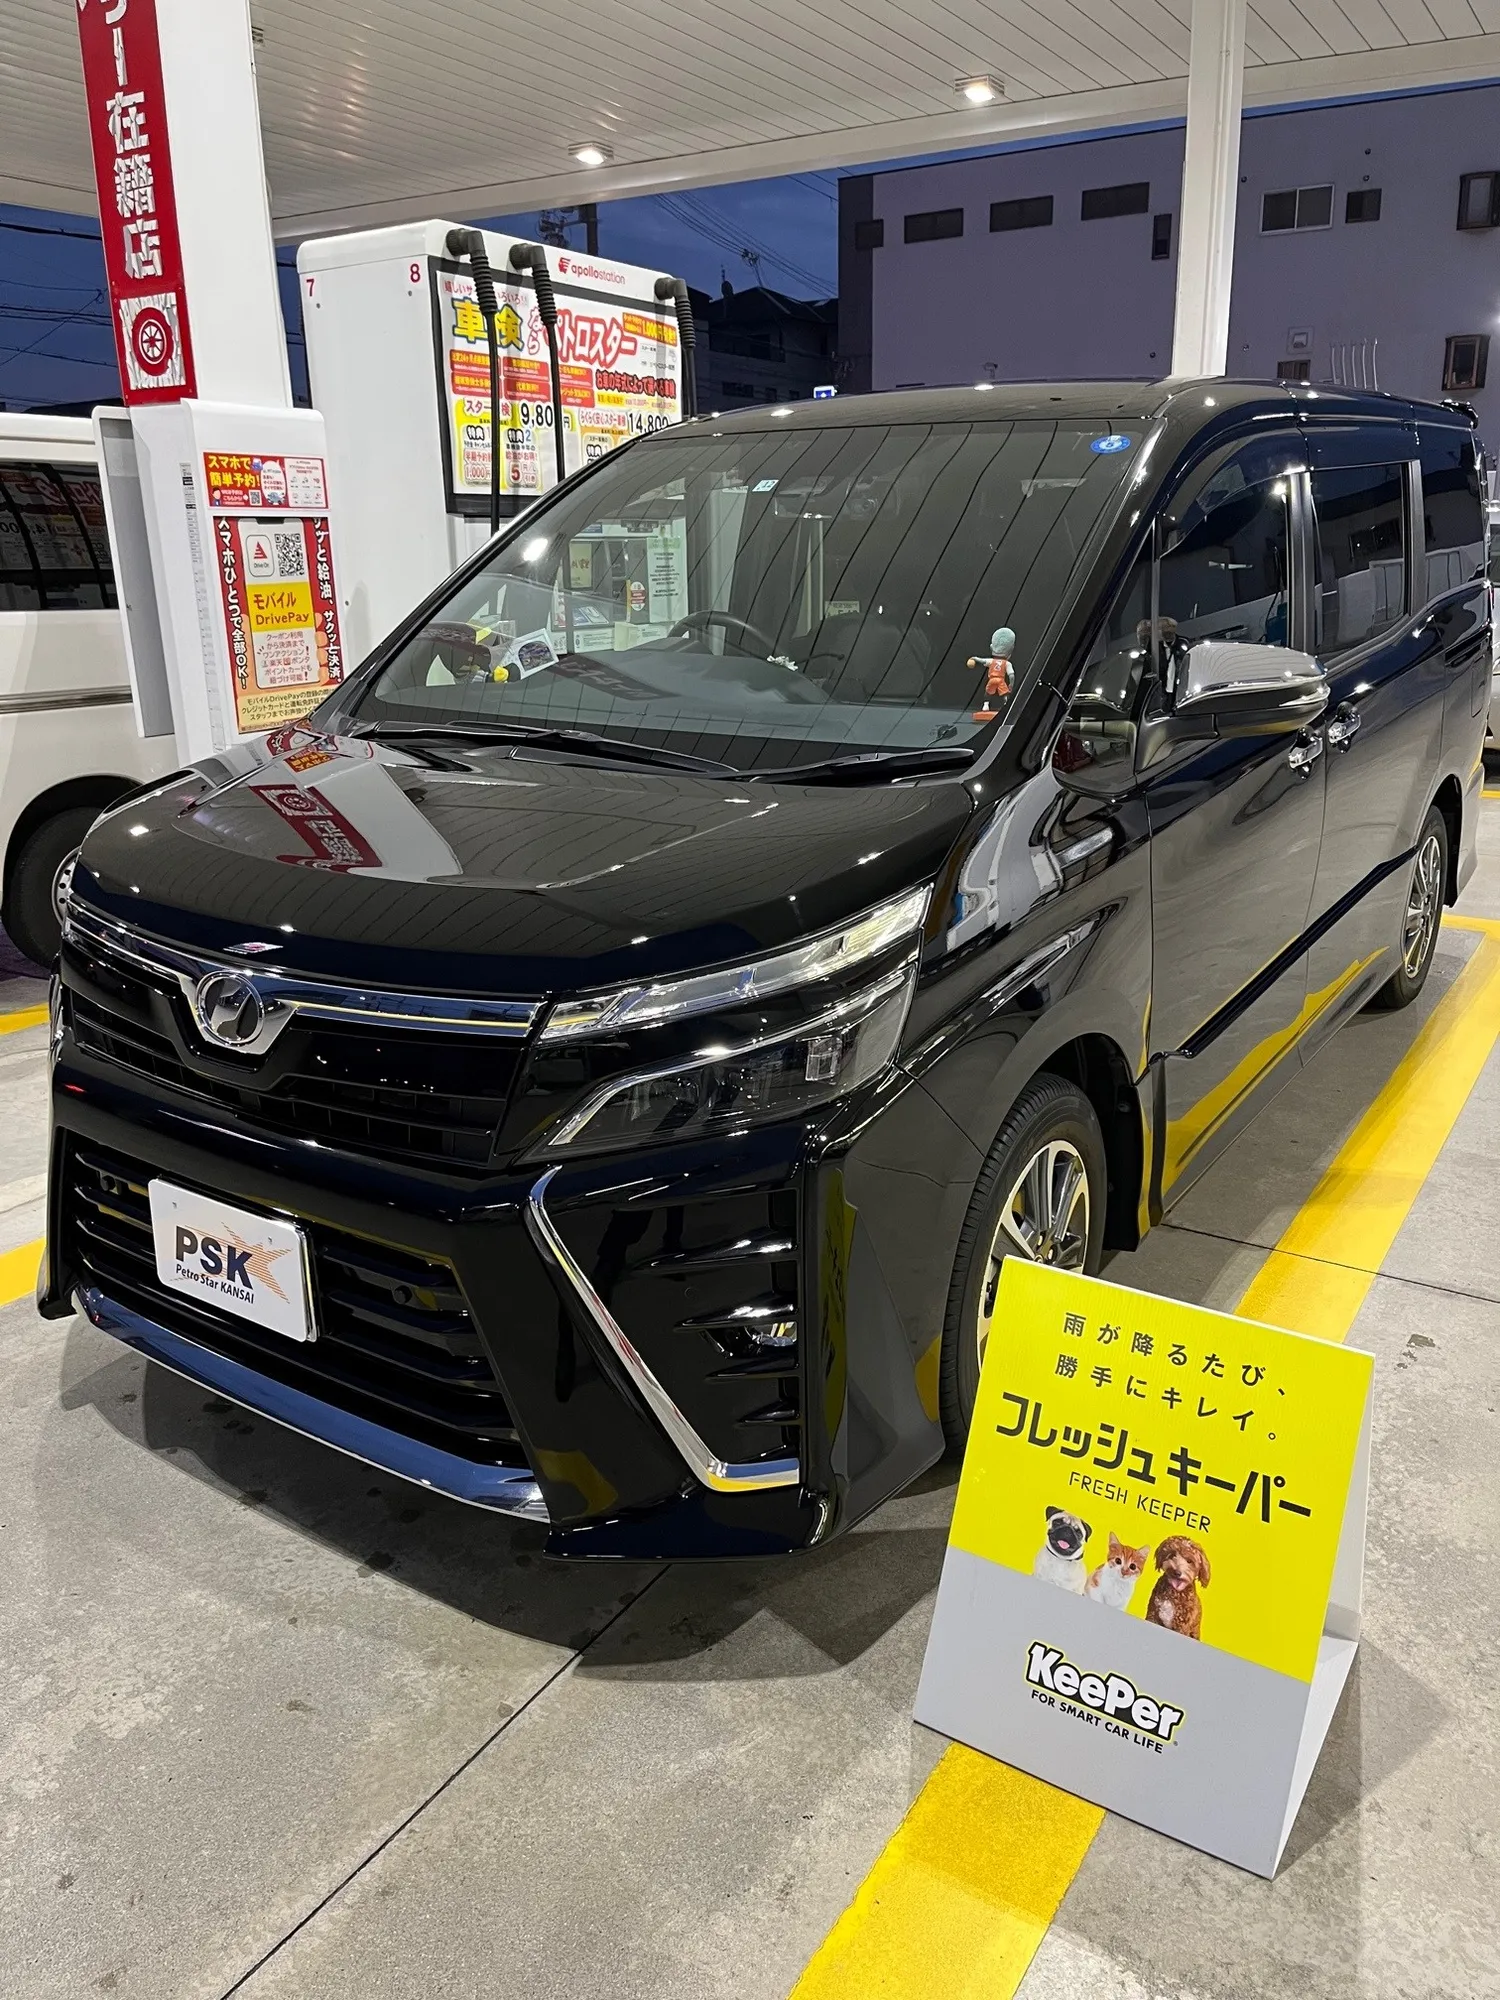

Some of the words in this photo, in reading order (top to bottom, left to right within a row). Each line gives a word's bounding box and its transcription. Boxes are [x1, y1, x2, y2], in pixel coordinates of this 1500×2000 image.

[410, 263, 421, 283] 8
[571, 264, 626, 285] apollostation
[306, 278, 315, 297] 7
[466, 400, 511, 419] スター検
[208, 455, 251, 470] スマホで
[209, 472, 260, 488] 簡単予約!
[511, 464, 520, 481] 5
[254, 591, 297, 610] モバイル
[256, 612, 310, 625] DrivePay
[266, 631, 304, 641] クーポン利用
[267, 640, 305, 650] から決済まで
[264, 666, 313, 676] ポイントカードも
[175, 1225, 254, 1291] PSK
[176, 1263, 200, 1282] Petro
[200, 1273, 219, 1290] Star
[220, 1282, 255, 1304] KANSAI
[1062, 1312, 1286, 1397] 雨が降るたび、
[1054, 1353, 1277, 1441] 勝手にキレイ。
[995, 1391, 1313, 1524] フレッシュキーパー
[1068, 1471, 1128, 1505] FRESH
[1136, 1495, 1212, 1534] KEEPER
[1026, 1641, 1184, 1741] KeePer
[1031, 1689, 1056, 1708] FOR
[1059, 1701, 1102, 1727] SMART
[1105, 1721, 1130, 1740] CAR
[1133, 1733, 1164, 1754] LIFE
